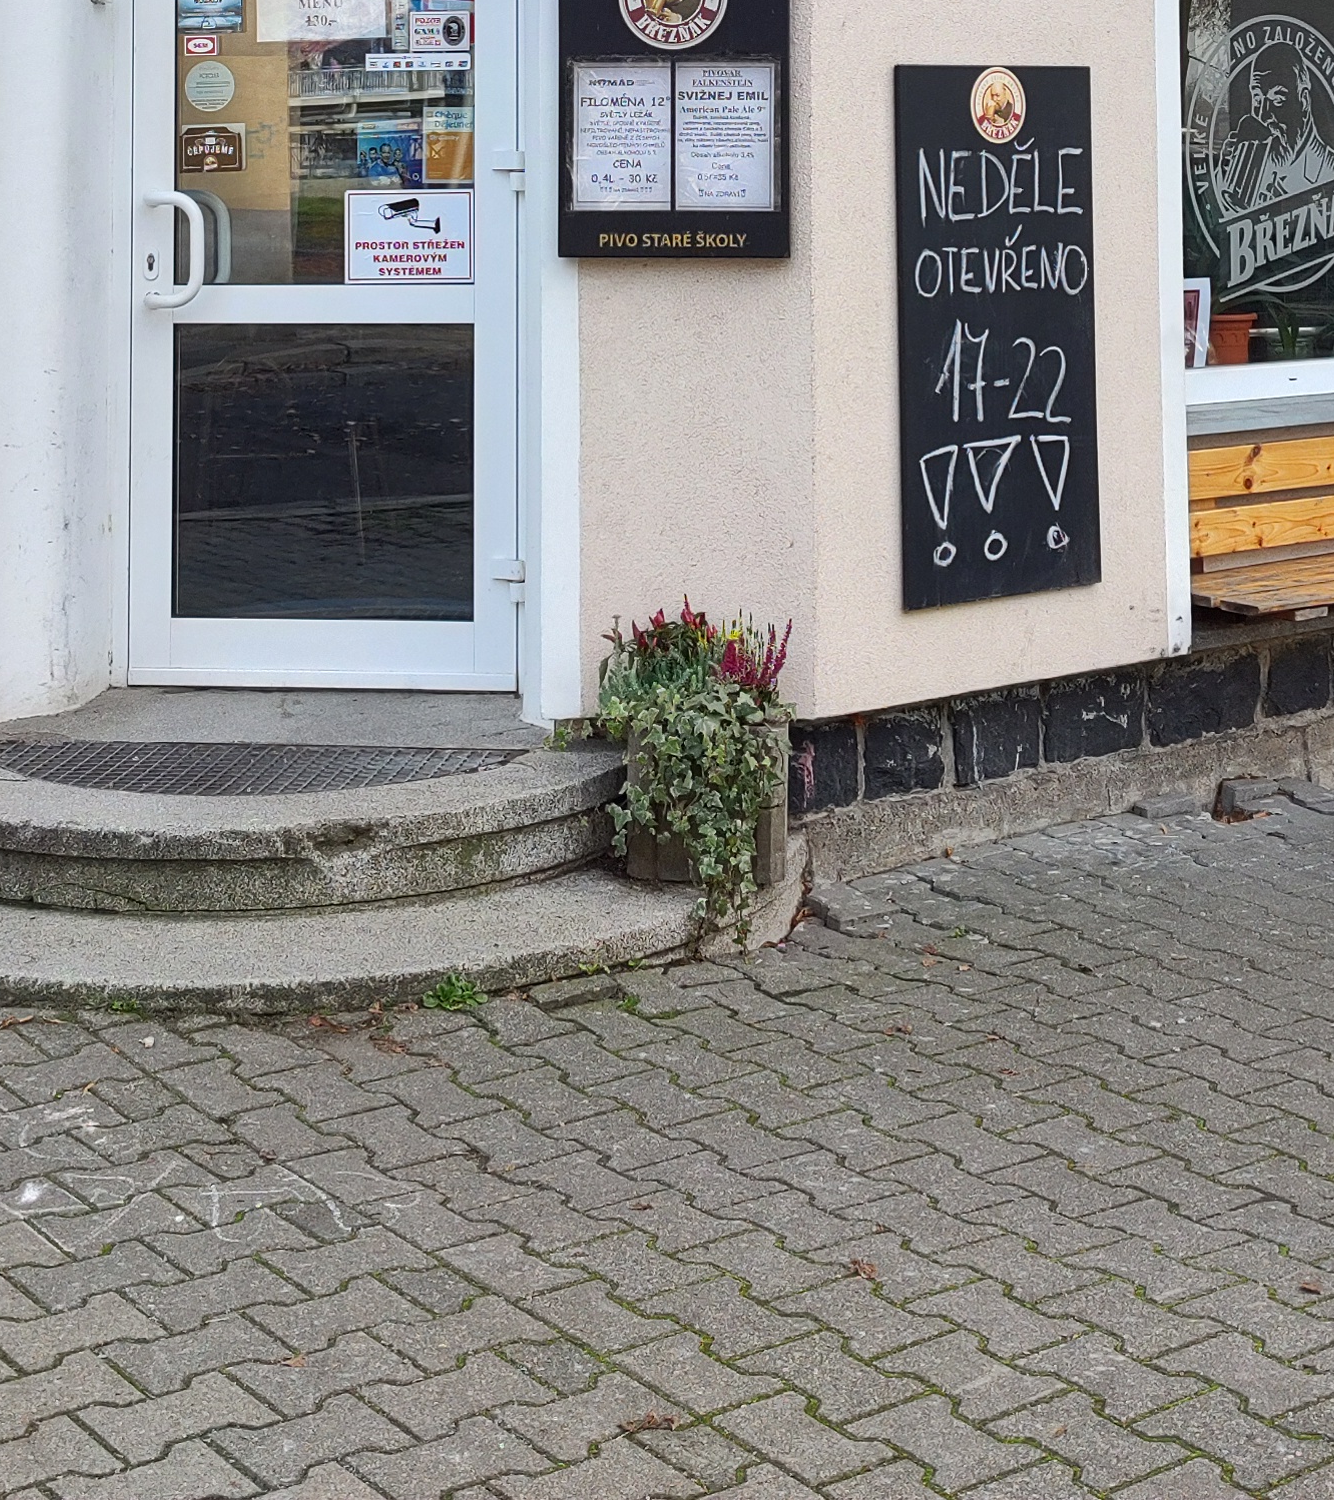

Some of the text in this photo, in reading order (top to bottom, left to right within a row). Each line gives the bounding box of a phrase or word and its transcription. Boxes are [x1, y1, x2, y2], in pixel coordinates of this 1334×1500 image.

[677, 89, 769, 101] SVIŽNEJ EMIL
[680, 105, 720, 113] American
[722, 105, 740, 113] Pale
[612, 159, 642, 168] CENA
[628, 173, 641, 184] 30
[645, 173, 659, 184] Kč
[918, 137, 1084, 227] NEDĚLE
[355, 238, 465, 250] PROSTOR STŘEŽEN
[599, 229, 747, 248] PIVO STARÉ ŠKOLY
[373, 252, 447, 263] KAMEROVÝM
[914, 224, 1089, 298] OTEVŘENO
[378, 265, 442, 276] SYSTÉMEM
[935, 318, 1071, 423] 17-22
